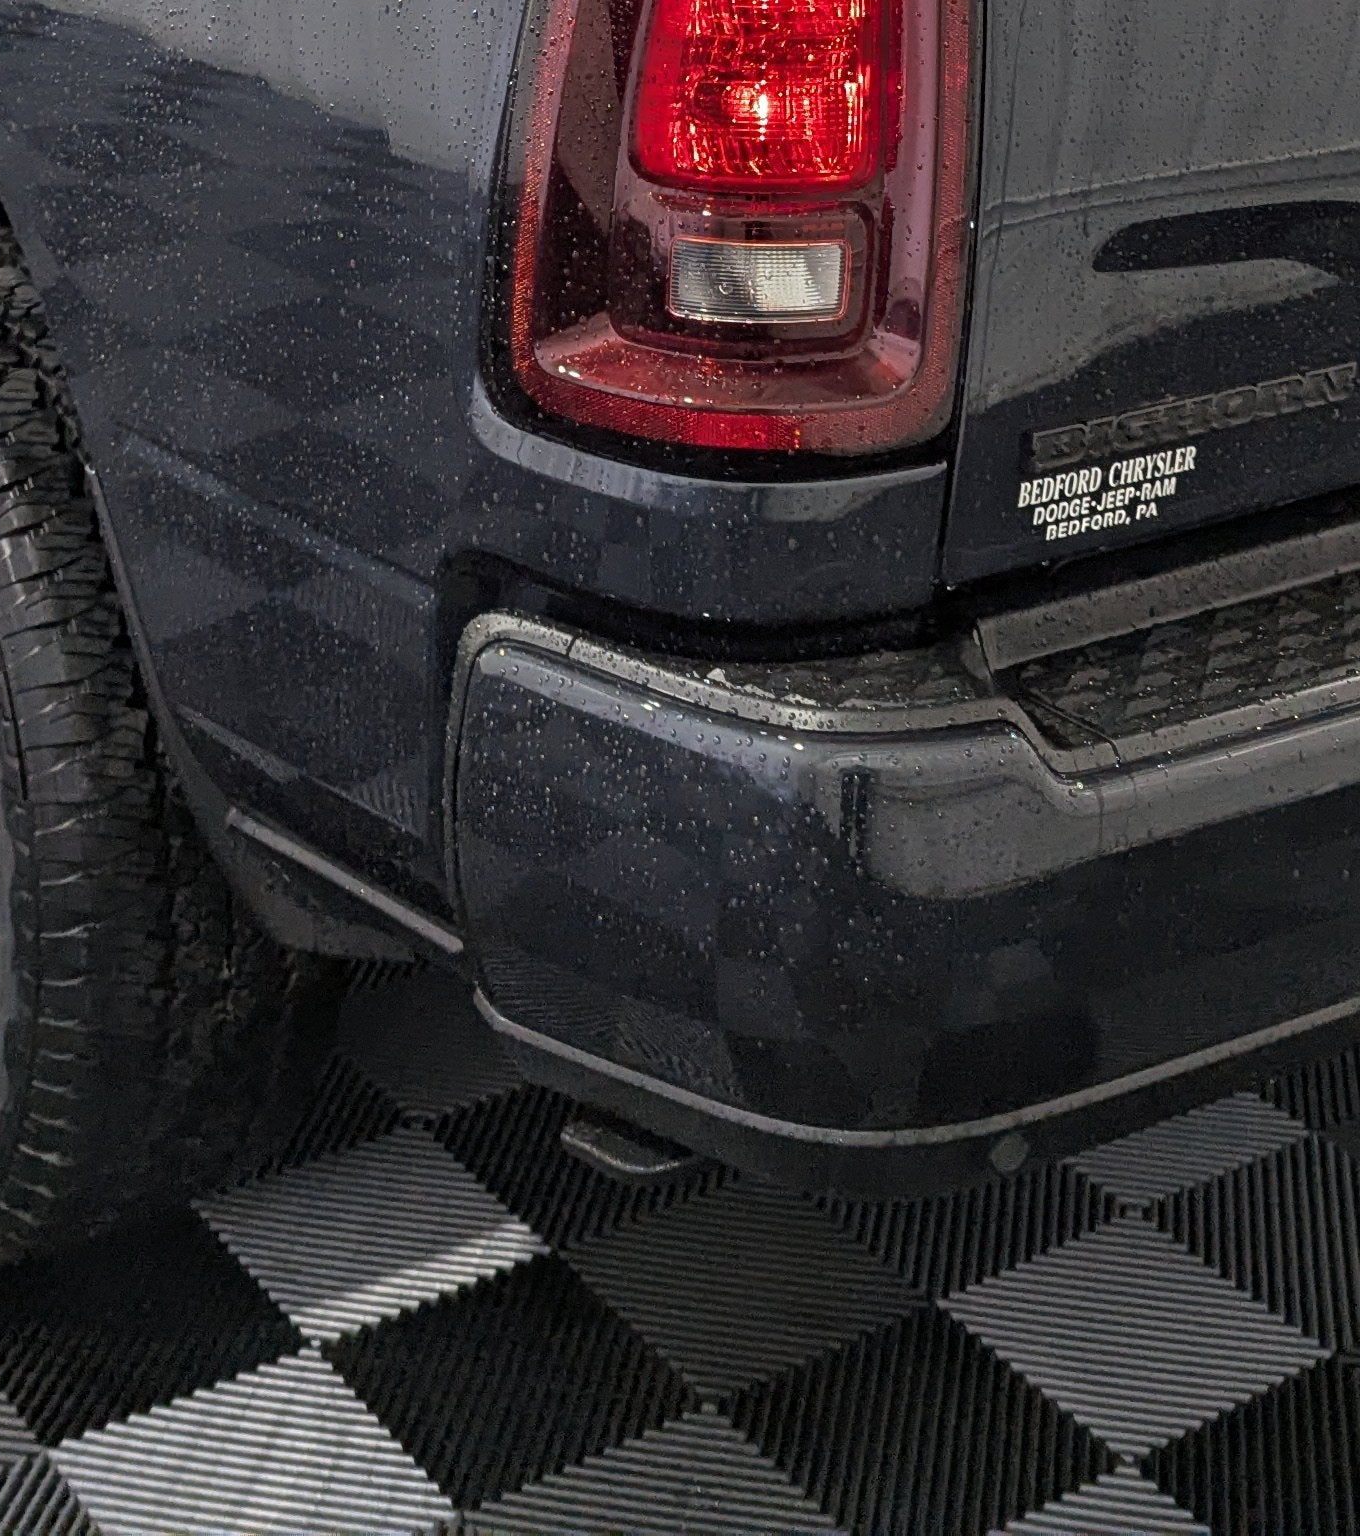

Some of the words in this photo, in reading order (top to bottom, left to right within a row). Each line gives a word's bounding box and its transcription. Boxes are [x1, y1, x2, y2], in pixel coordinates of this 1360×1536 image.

[1018, 466, 1102, 508] BEDFORD
[1108, 445, 1197, 488] CHRYSLER
[1045, 509, 1131, 541] BEDFORD,
[1135, 501, 1158, 520] PA
